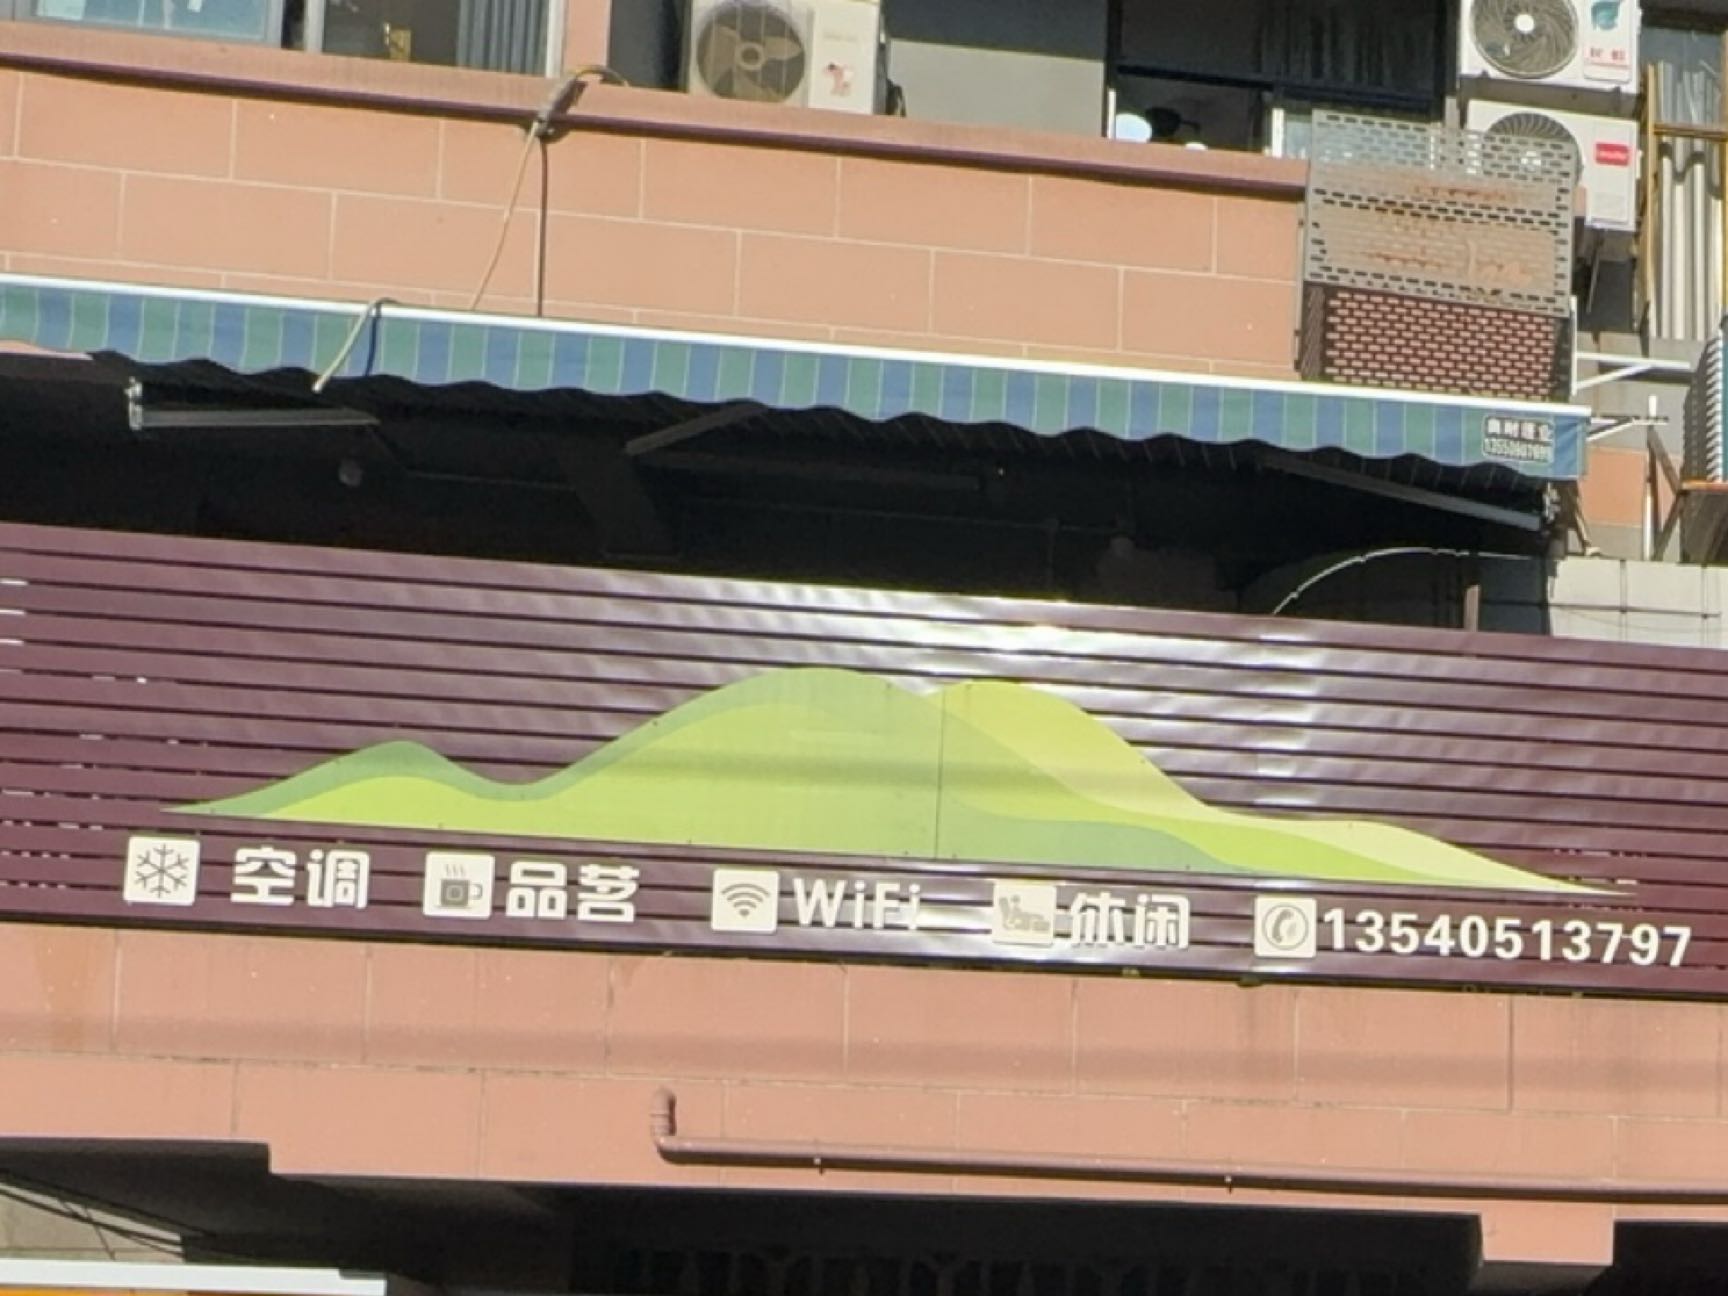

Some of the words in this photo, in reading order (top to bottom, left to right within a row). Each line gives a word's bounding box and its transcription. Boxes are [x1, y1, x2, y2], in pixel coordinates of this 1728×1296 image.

[230, 846, 370, 910] 空调
[506, 861, 639, 923] 品茗
[793, 877, 921, 931] WiFi
[1323, 907, 1692, 967] 13540513797
